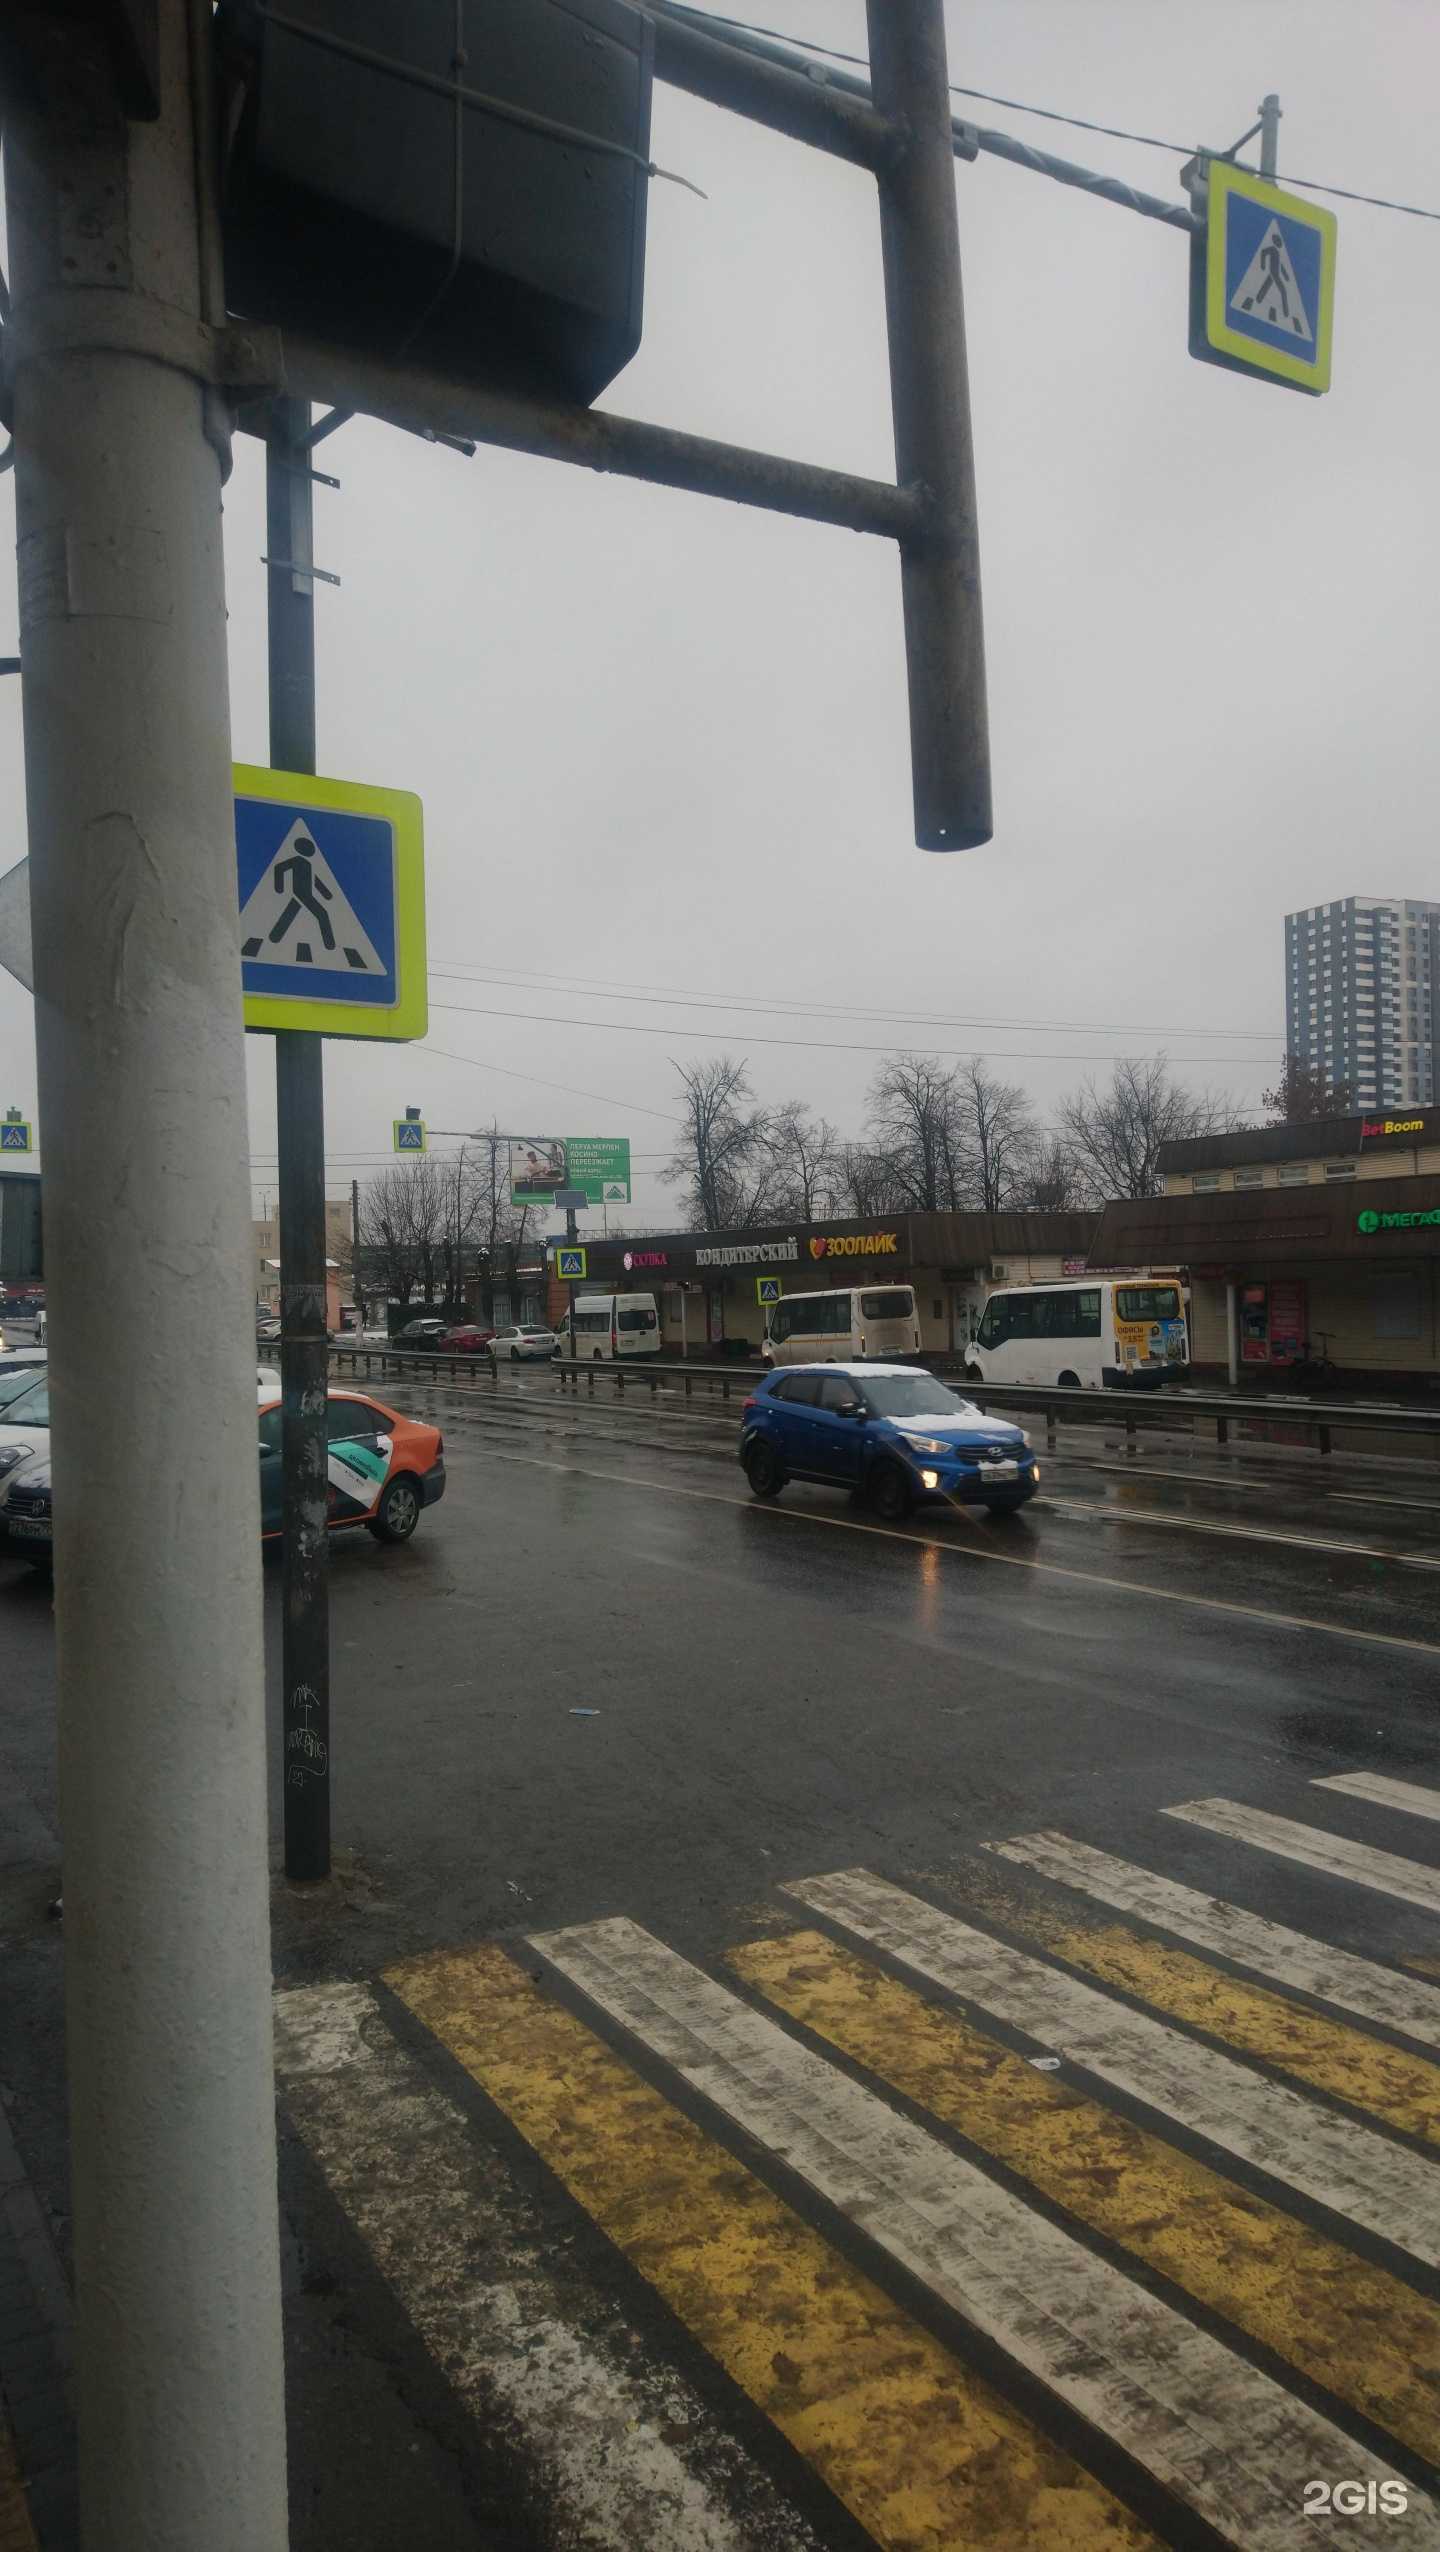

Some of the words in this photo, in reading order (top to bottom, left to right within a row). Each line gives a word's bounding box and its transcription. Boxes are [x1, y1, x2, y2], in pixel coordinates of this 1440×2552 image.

[1362, 1119, 1424, 1136] BetBoom
[696, 1237, 799, 1266] КОНДИТЕРСКИЙ
[827, 1232, 897, 1257] ЗООЛАЙК
